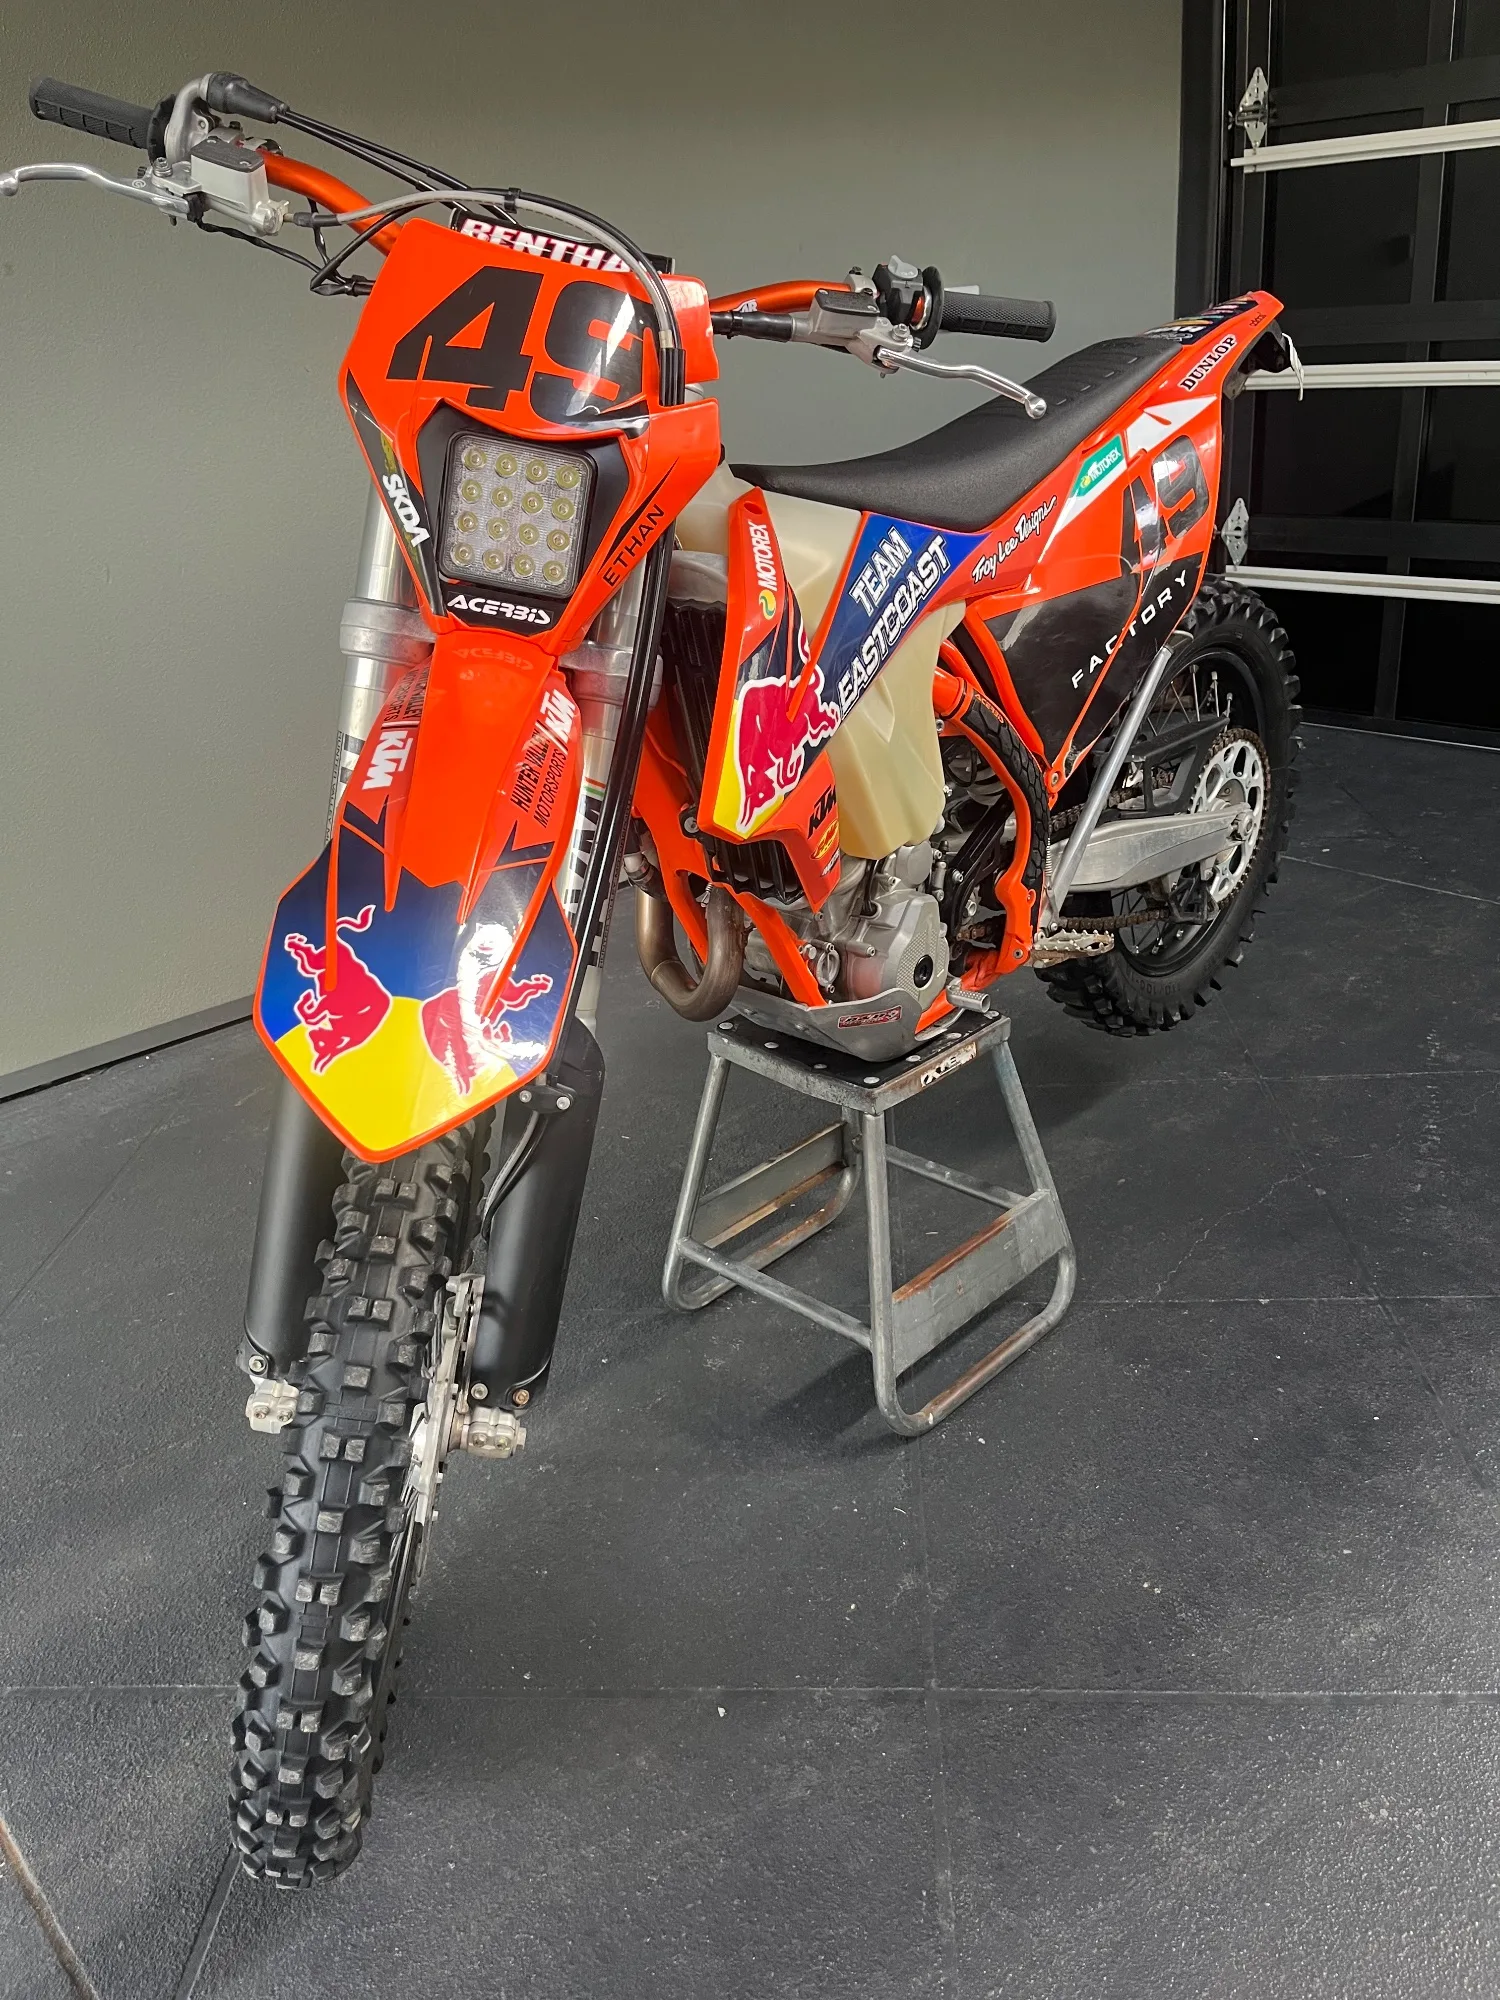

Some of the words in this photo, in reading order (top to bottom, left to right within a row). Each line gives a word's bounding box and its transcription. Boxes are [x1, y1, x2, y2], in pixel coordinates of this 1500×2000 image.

[461, 218, 633, 273] RENTHA
[386, 265, 653, 432] 49
[1179, 334, 1237, 392] DUNLOP
[1089, 446, 1122, 483] MOTOREX
[382, 473, 430, 547] SKDA
[602, 503, 665, 587] ETHAN
[748, 519, 777, 592] MOTOREX
[849, 526, 912, 617] TEAM
[972, 554, 998, 584] Troy
[998, 540, 1019, 564] Lee
[447, 594, 551, 625] ACERBIS
[836, 534, 951, 721] EASTCOAST
[1071, 569, 1186, 689] FACTORY
[540, 688, 576, 743] KTM
[362, 730, 414, 790] KTM
[510, 763, 542, 813] HUNTER
[533, 748, 567, 829] MOTORSPORTS
[807, 784, 837, 840] KTM
